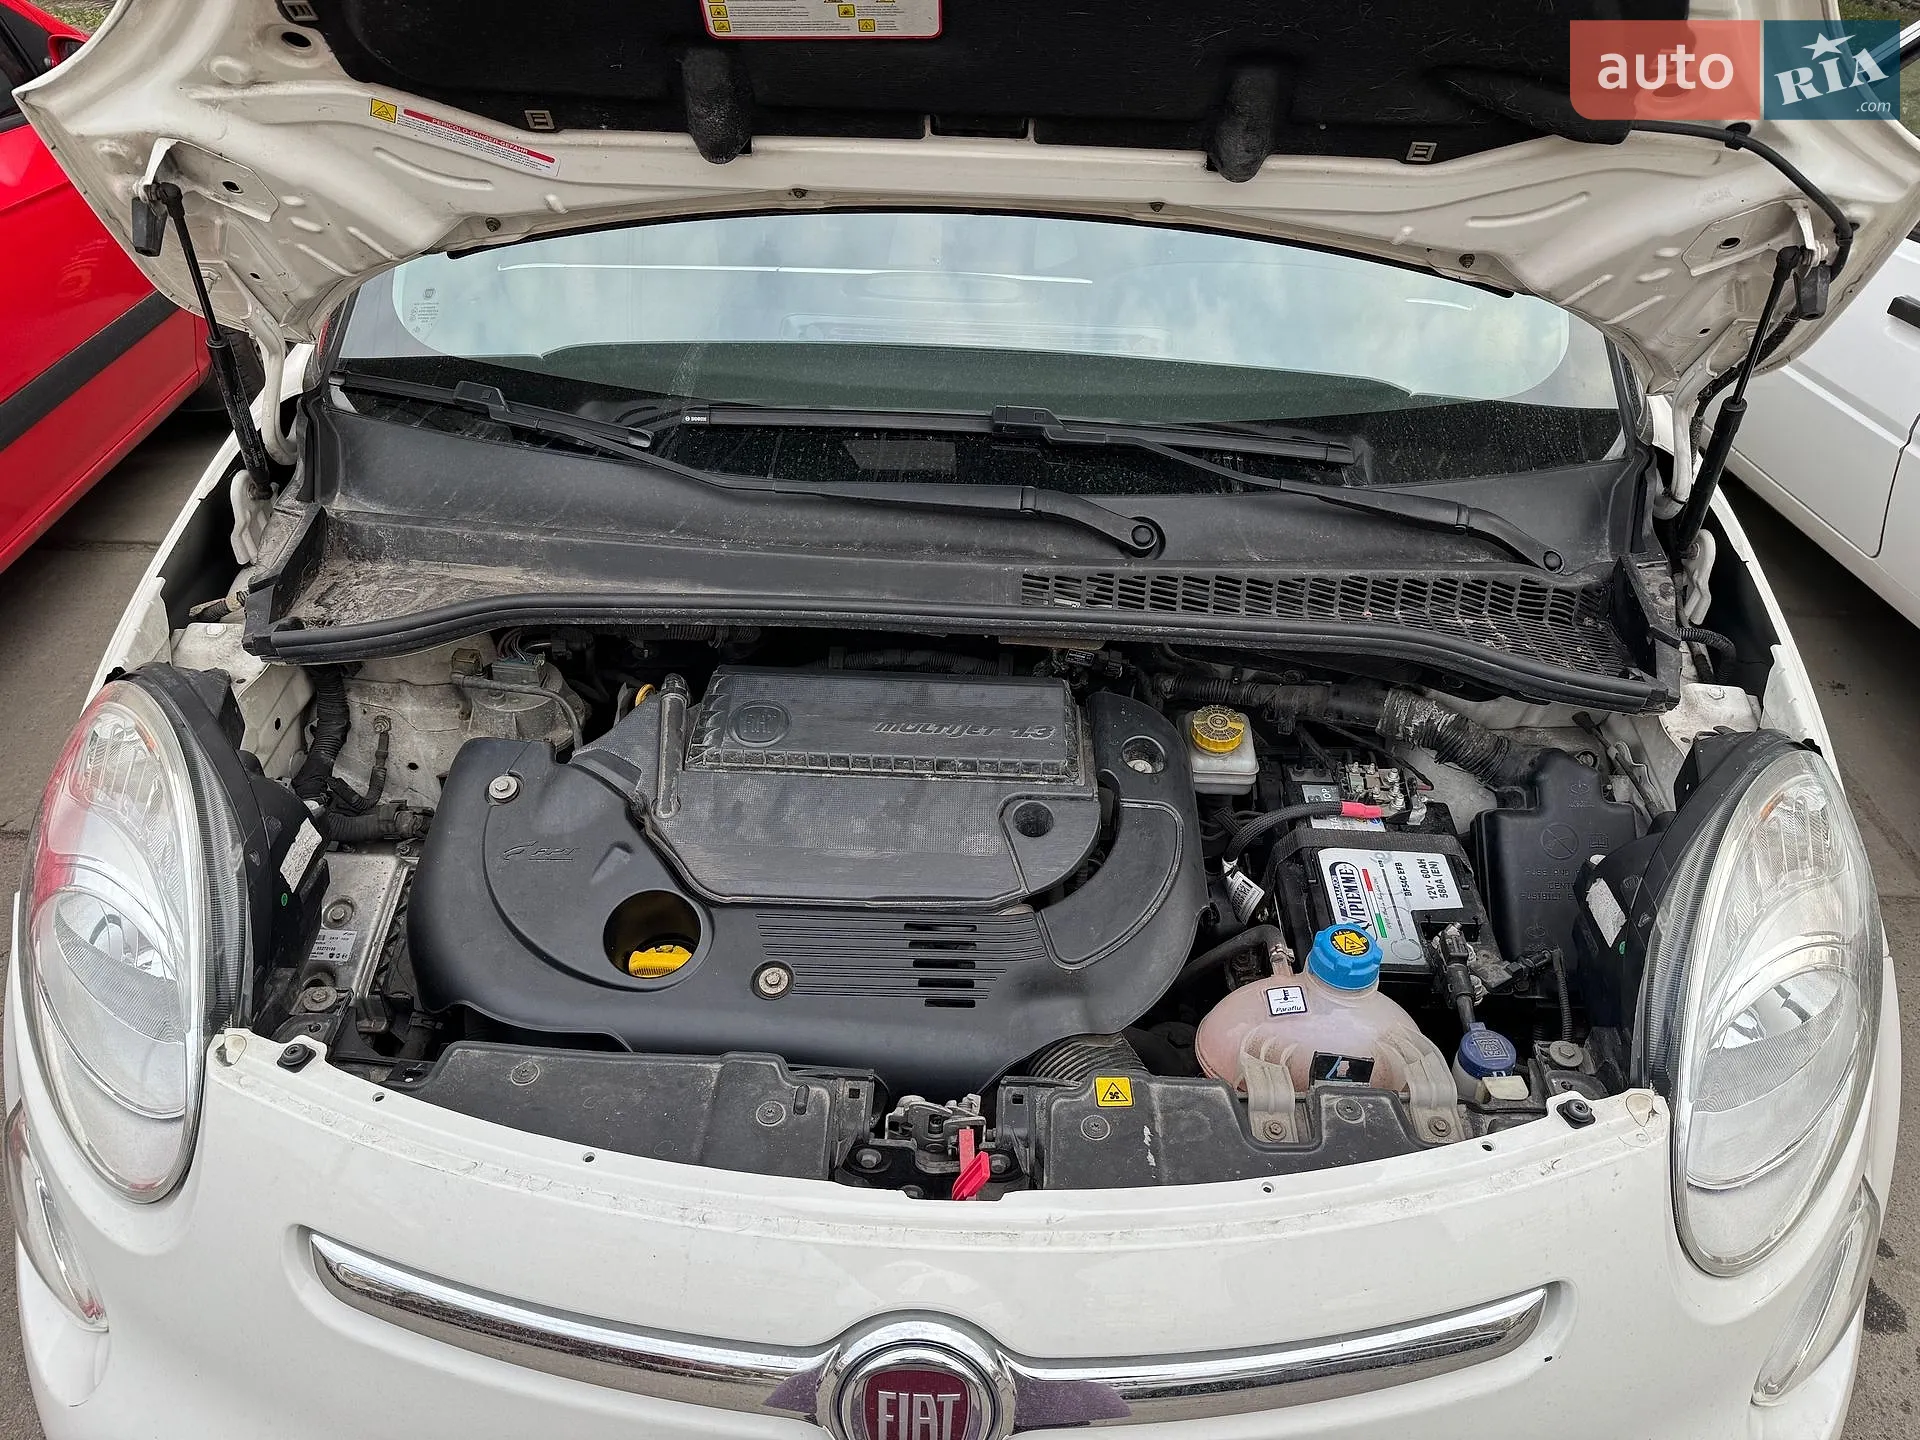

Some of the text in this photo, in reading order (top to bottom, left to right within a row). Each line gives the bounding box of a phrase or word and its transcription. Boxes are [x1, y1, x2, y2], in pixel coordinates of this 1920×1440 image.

[1394, 862, 1406, 875] EFB
[1416, 858, 1431, 879] 60AH
[1428, 861, 1449, 899] 580A (EN)
[1339, 868, 1368, 924] VIPIEMME
[1425, 884, 1438, 900] 12V
[1275, 1005, 1302, 1013] Paraflu
[878, 1390, 961, 1440] FIAT
